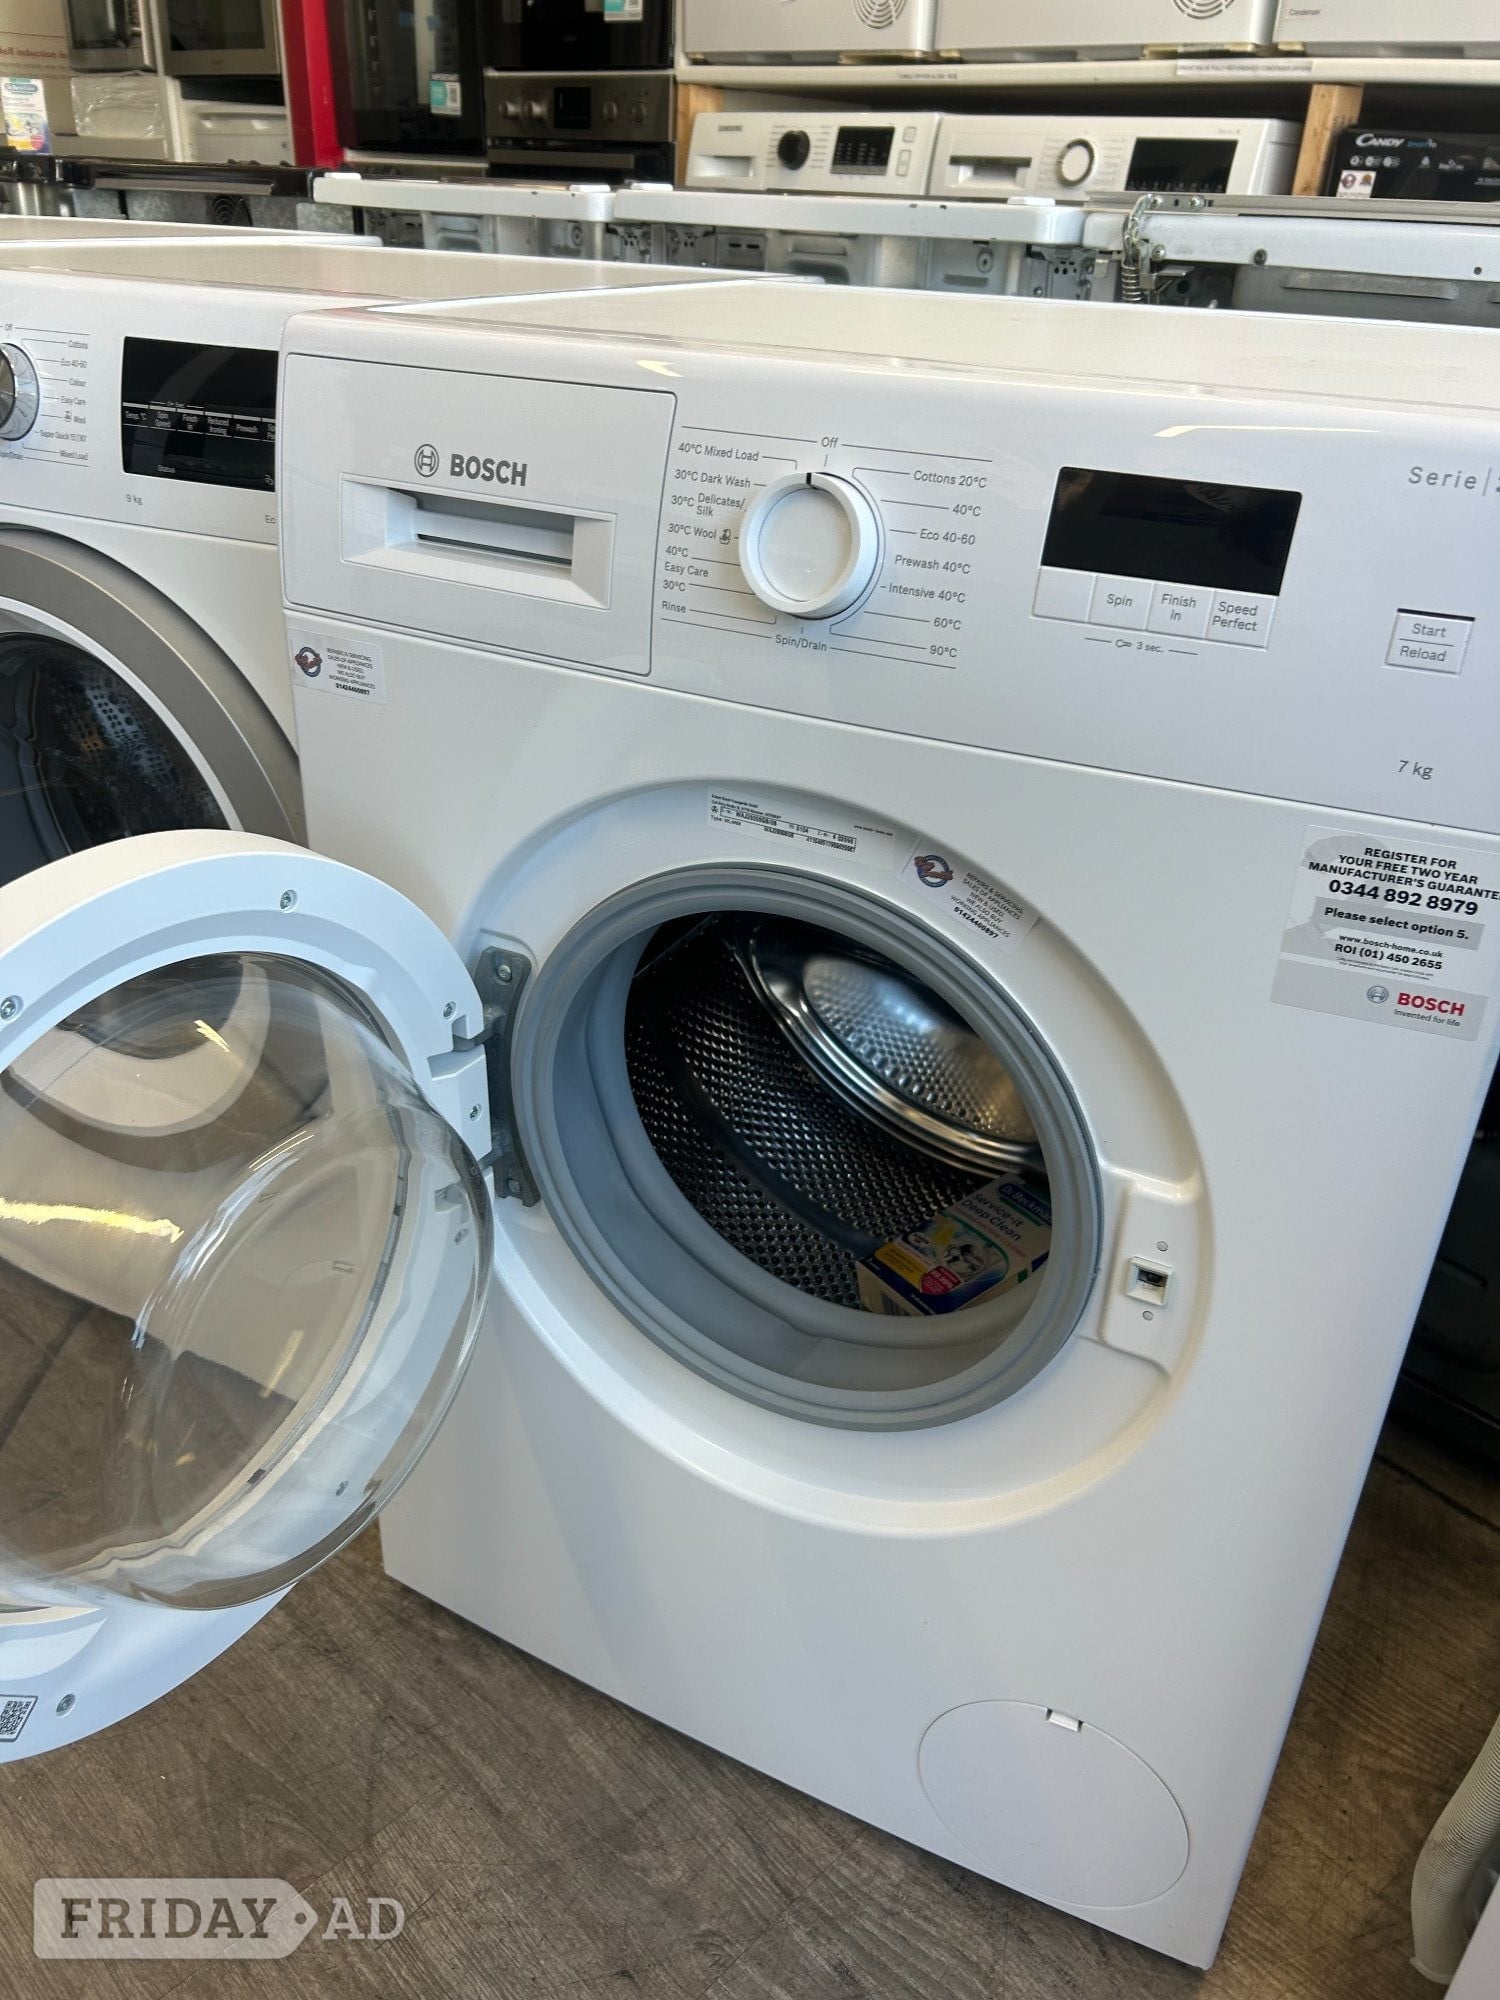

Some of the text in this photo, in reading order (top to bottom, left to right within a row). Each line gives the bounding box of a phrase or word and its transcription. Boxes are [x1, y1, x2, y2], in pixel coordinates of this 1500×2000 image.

[1355, 133, 1405, 148] CANDY
[678, 442, 759, 461] 40°C Mixed Load
[820, 436, 839, 448] Off
[450, 453, 528, 487] BOSCH
[674, 469, 751, 488] 30°C Dark Wash
[913, 470, 987, 489] Cottons 20°C
[1408, 466, 1477, 490] Serie
[671, 494, 695, 507] 30°C
[952, 503, 982, 517] 40°C
[696, 505, 714, 517] Silk
[667, 523, 717, 540] 30°C Wool
[919, 528, 976, 545] Eco 40-60
[665, 545, 689, 558] 40°C
[664, 561, 709, 577] Easy Care
[894, 554, 971, 575] Prewash 40°C
[662, 579, 686, 592] 30°C
[888, 582, 966, 603] Intensive 40°C
[661, 600, 687, 613] Rinse
[1106, 593, 1133, 608] Spin
[1161, 593, 1197, 609] Finish
[1218, 601, 1258, 617] Speed
[933, 617, 962, 631] 60°C
[1170, 609, 1182, 621] in
[1212, 616, 1258, 632] Perfect
[1412, 623, 1447, 638] Start
[775, 634, 827, 652] Spin/Drain
[929, 645, 958, 658] 90°C
[1136, 641, 1164, 653] 3 sec.
[1400, 645, 1447, 663] Reload
[1397, 759, 1433, 781] 7 kg
[1364, 847, 1457, 870] REGISTER FOR
[1338, 854, 1479, 885] YOUR FREE TWO YEAR
[1308, 861, 1500, 901] MANUFACTURER'S GUARANTE
[962, 878, 980, 892] SALES
[987, 896, 1021, 920] APPLIANCES
[970, 892, 983, 903] NEW
[989, 906, 1004, 917] USED
[1328, 879, 1479, 916] 0344 892 8979
[950, 896, 1010, 937] WORKING APPLIANCES
[966, 897, 1003, 923] WE ALSO BUY
[1324, 906, 1470, 940] Please select option 5.
[1338, 934, 1443, 958] www.bosch-home.co.uk
[1334, 943, 1358, 955] ROI
[1359, 947, 1385, 961] (01)
[1386, 952, 1410, 965] 450
[1411, 957, 1443, 970] 2655
[1397, 992, 1466, 1016] BOSCH
[1394, 1008, 1461, 1028] Invented for life
[974, 1193, 1024, 1228] Service-it
[961, 1200, 991, 1221] Deep
[988, 1215, 1022, 1242] Clean
